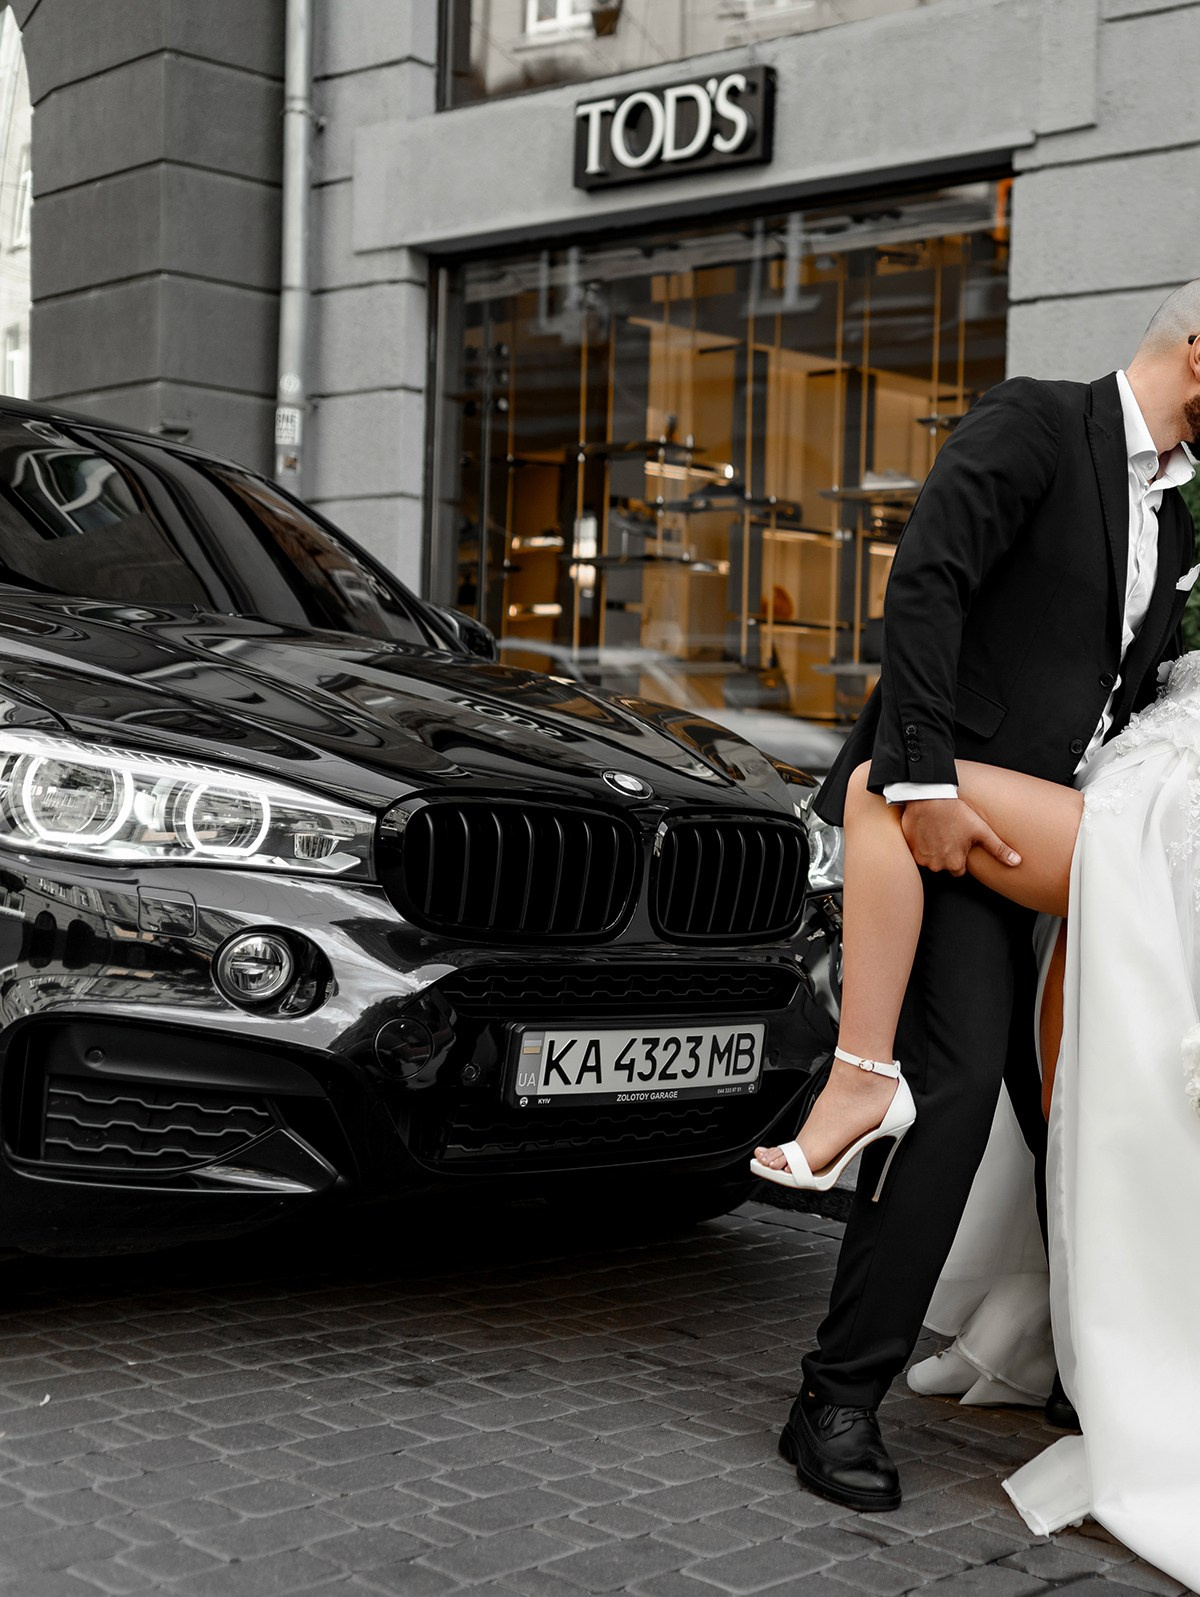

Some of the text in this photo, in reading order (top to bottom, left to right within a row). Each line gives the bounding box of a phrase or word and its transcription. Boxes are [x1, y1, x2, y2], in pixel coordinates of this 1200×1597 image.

[575, 73, 748, 174] TOD'S
[543, 1033, 756, 1086] KA 4323 MB
[518, 1072, 536, 1087] UA
[616, 1090, 679, 1102] ZOLOTOY GARAGE
